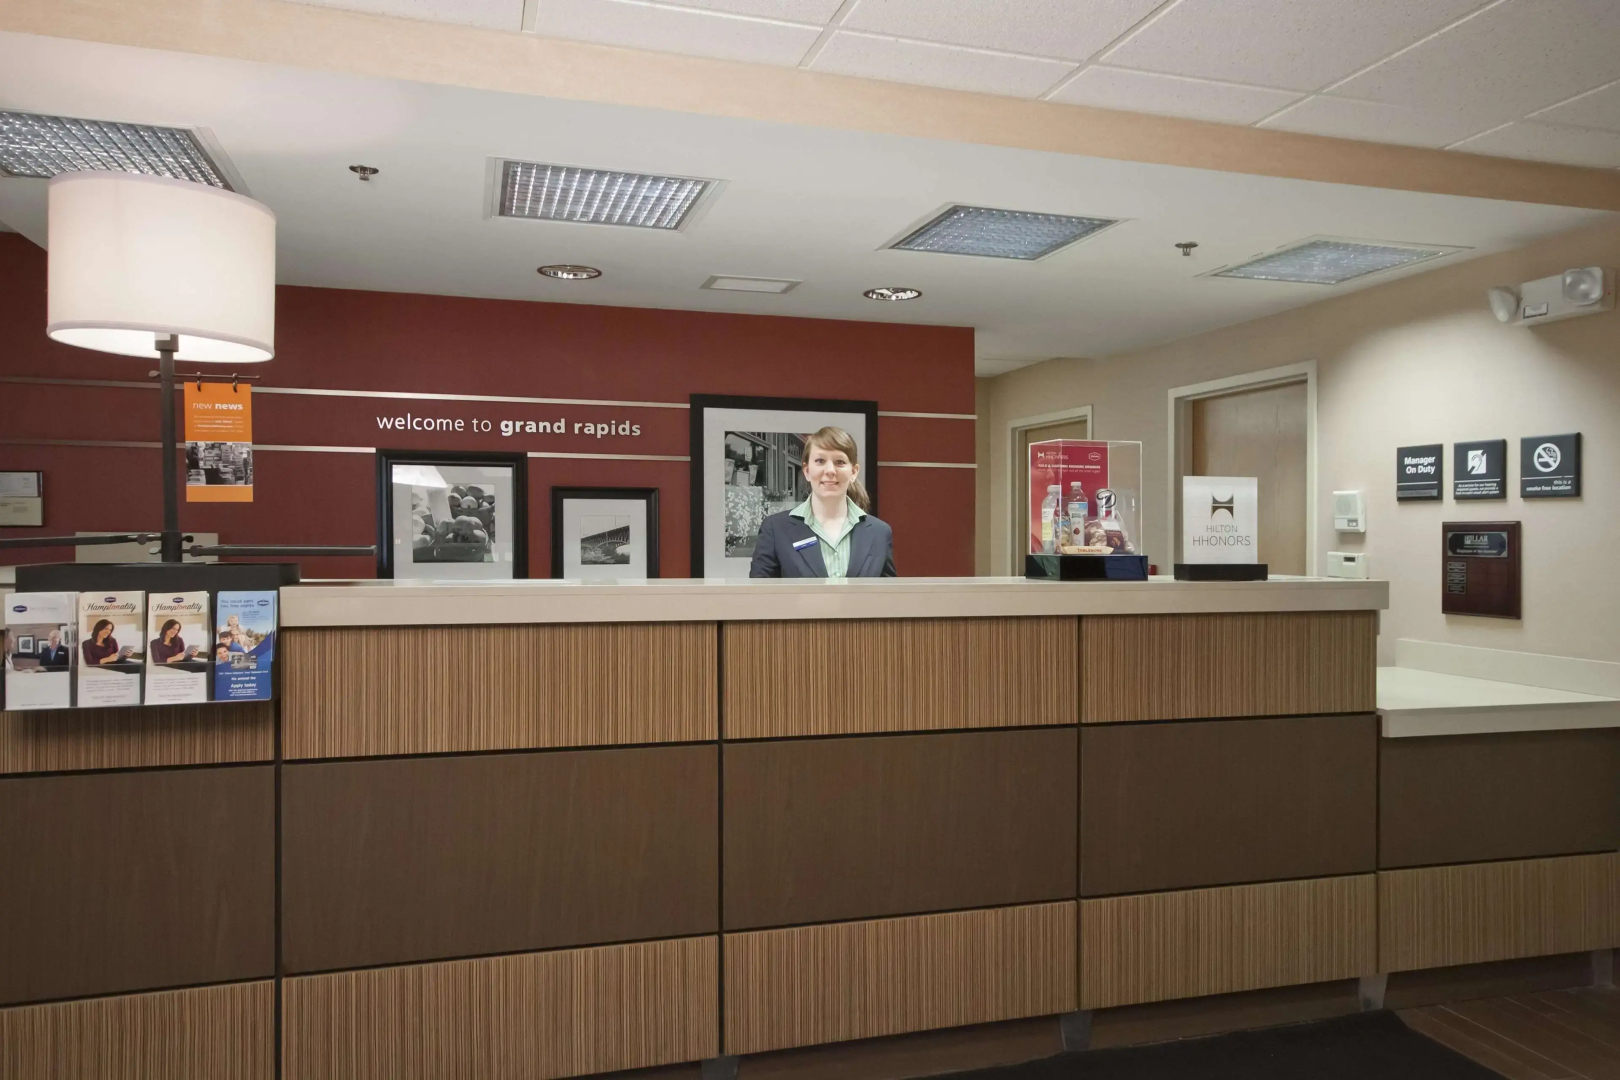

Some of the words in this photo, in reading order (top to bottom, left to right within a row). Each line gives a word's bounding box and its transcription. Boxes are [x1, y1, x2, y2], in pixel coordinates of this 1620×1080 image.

[376, 413, 464, 431] welcome
[472, 418, 492, 432] to
[500, 418, 566, 436] grand
[574, 420, 641, 438] rapids
[1404, 456, 1436, 465] Manager
[1406, 466, 1416, 474] On
[1418, 465, 1435, 474] Duty
[1192, 536, 1250, 546] HHONORS
[83, 602, 136, 612] Hamptonality
[152, 602, 202, 612] Hamptonality
